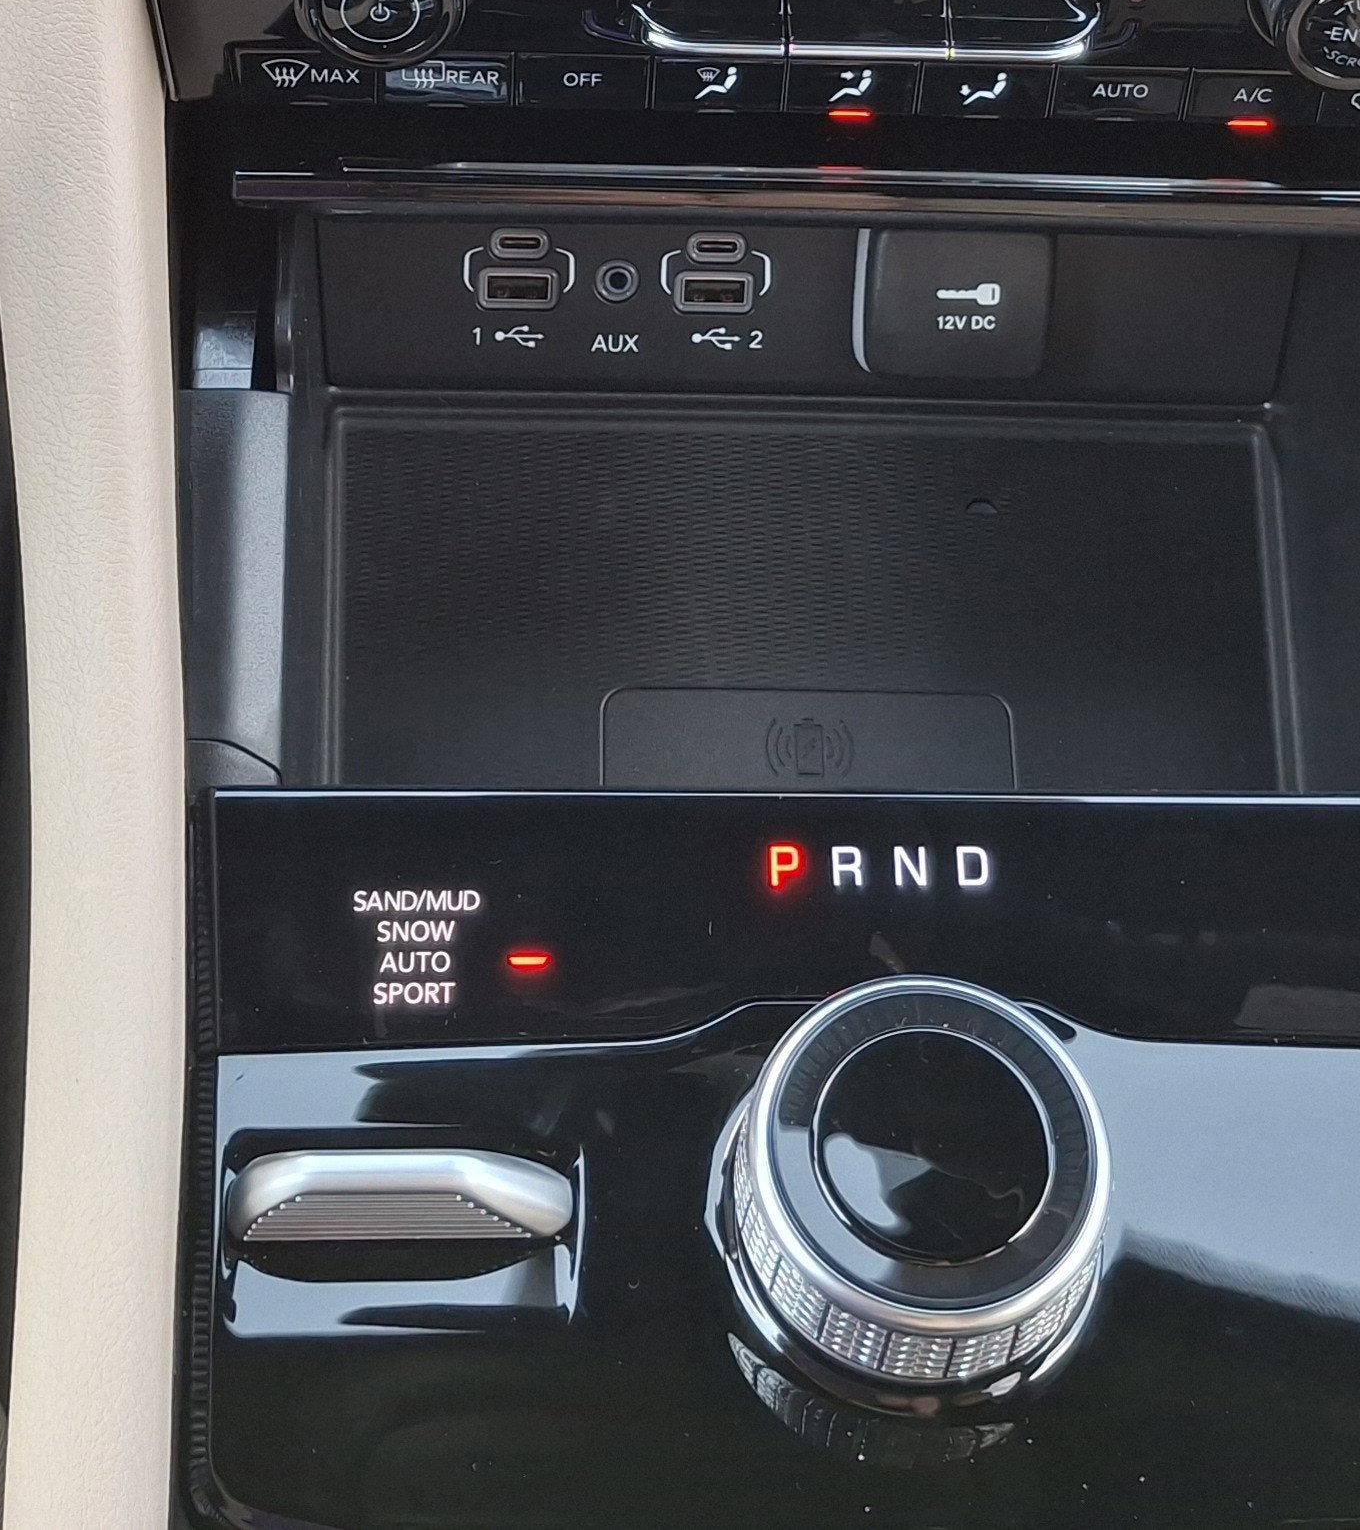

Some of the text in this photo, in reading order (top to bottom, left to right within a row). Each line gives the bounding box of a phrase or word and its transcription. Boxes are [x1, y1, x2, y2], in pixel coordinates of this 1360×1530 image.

[311, 68, 361, 84] MAX
[446, 70, 499, 85] REAR
[563, 72, 603, 88] OFF
[1092, 83, 1149, 99] AUTO
[1233, 87, 1273, 104] A/C
[937, 315, 996, 331] 12V DC
[472, 327, 483, 346] 1
[591, 334, 639, 354] AUX
[748, 331, 763, 350] 2
[768, 845, 989, 888] P R N D
[353, 889, 480, 913] SAND/MUD
[376, 920, 455, 943] SNOW
[379, 950, 451, 974] AUTO
[372, 981, 455, 1005] SPORT
